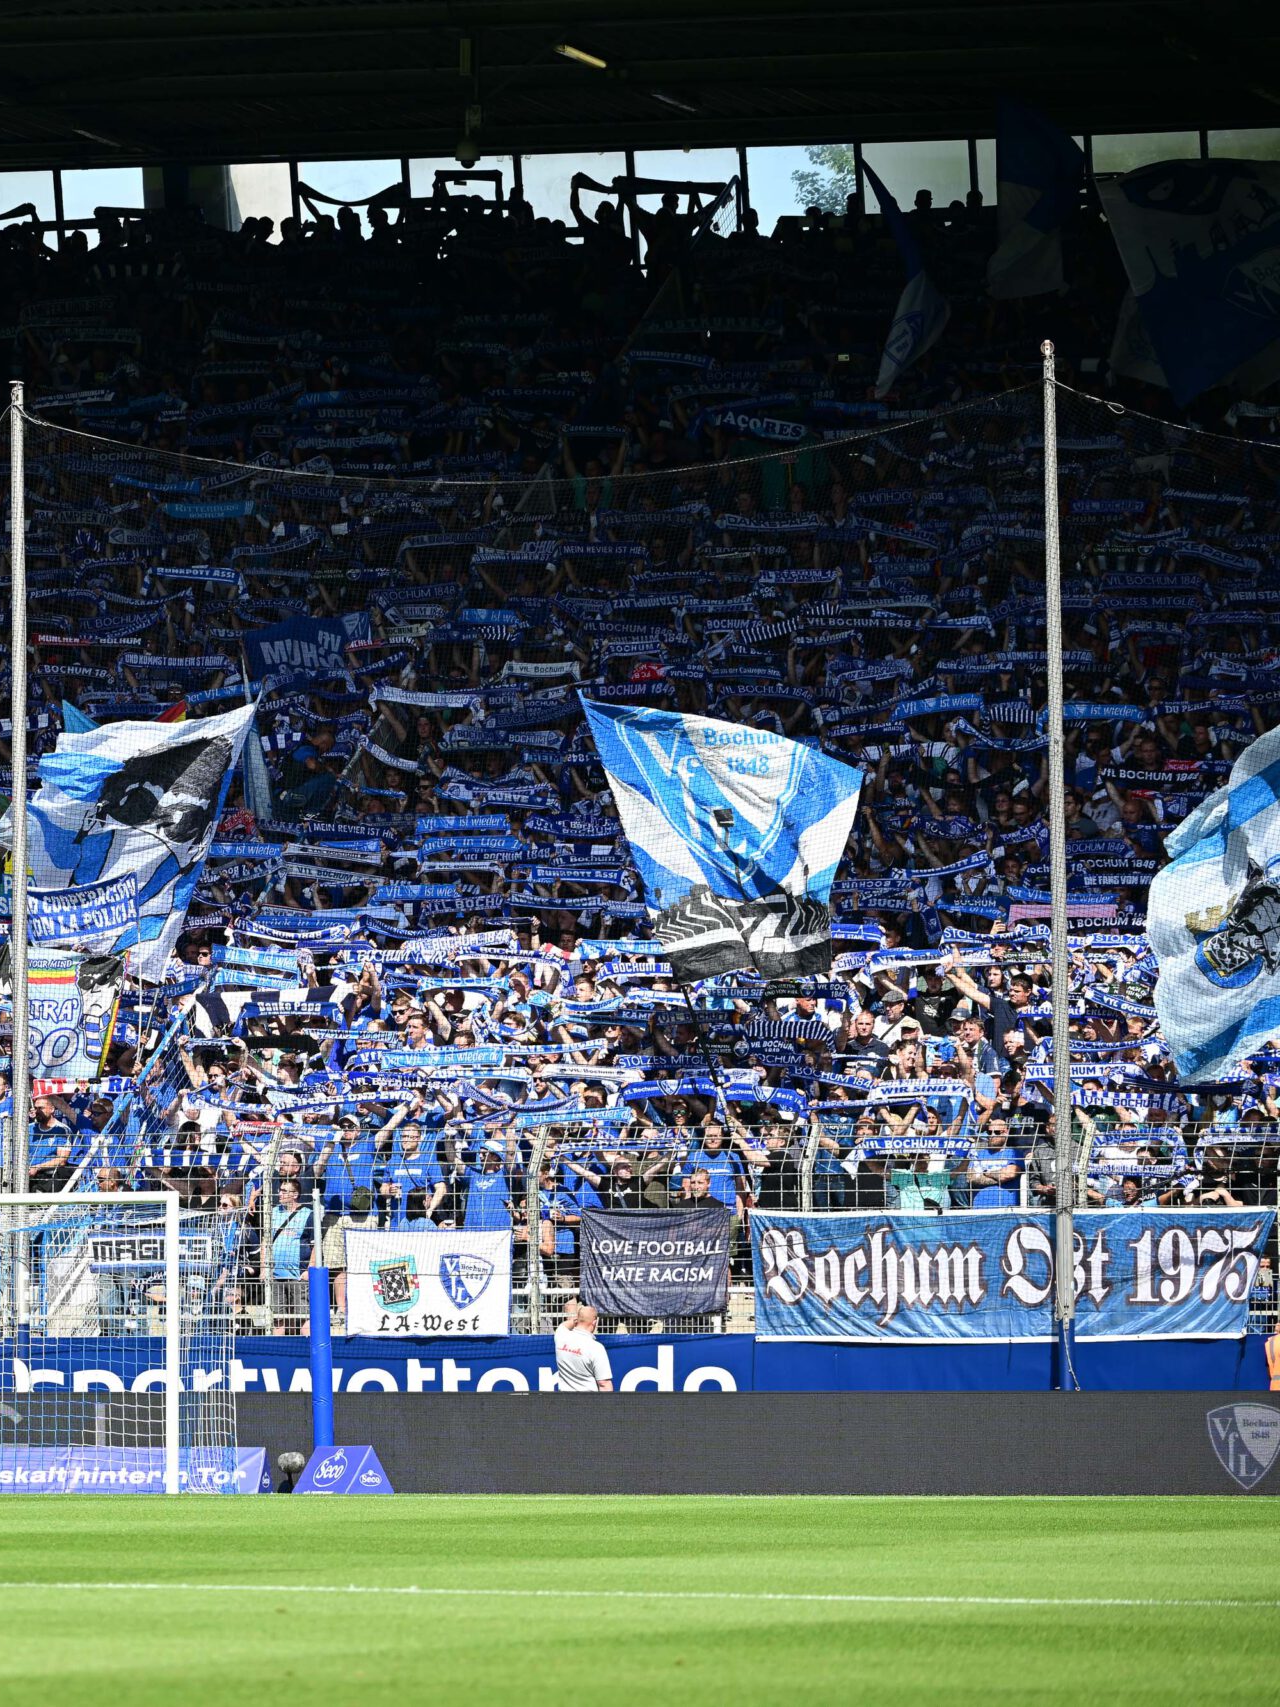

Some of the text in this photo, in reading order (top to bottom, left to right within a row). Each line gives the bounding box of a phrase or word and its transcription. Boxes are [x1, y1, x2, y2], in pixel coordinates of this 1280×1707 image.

[826, 617, 881, 628] BOCHUM
[883, 617, 912, 628] 1848
[598, 683, 647, 697] BOCHUM
[1103, 705, 1132, 717] wieder
[726, 756, 770, 775] 1848
[1119, 768, 1174, 782] BOCHUM
[314, 822, 381, 837] MEIN REVIER IST
[421, 815, 502, 831] VfL ist wieder
[234, 843, 281, 856] ist wieder
[1077, 916, 1128, 929] BOCHUM
[252, 923, 296, 938] BOCHUM
[297, 931, 323, 941] 1848
[49, 959, 74, 970] MIND
[357, 950, 410, 965] BOCHUM
[613, 963, 656, 975] BOCHUM
[291, 1001, 322, 1014] Papa
[383, 1053, 402, 1066] Der
[404, 1051, 424, 1065] VfL
[443, 1051, 456, 1063] ist
[456, 1050, 487, 1063] wieder
[618, 1055, 666, 1068] STOLZES
[631, 1085, 660, 1095] Bochum
[726, 1088, 754, 1096] Bochum
[880, 1084, 935, 1096] WIR SIND
[1111, 1097, 1160, 1109] BOCHUM
[886, 1138, 942, 1152] BOCHUM
[592, 1238, 724, 1257] LOVE FOOTBALL
[602, 1264, 714, 1284] HATE RACISM
[762, 1226, 986, 1326] Bochum
[1127, 1222, 1262, 1304] 1975
[198, 1465, 247, 1485] Tor
[315, 1457, 345, 1487] Seco
[361, 1472, 381, 1485] Seco
